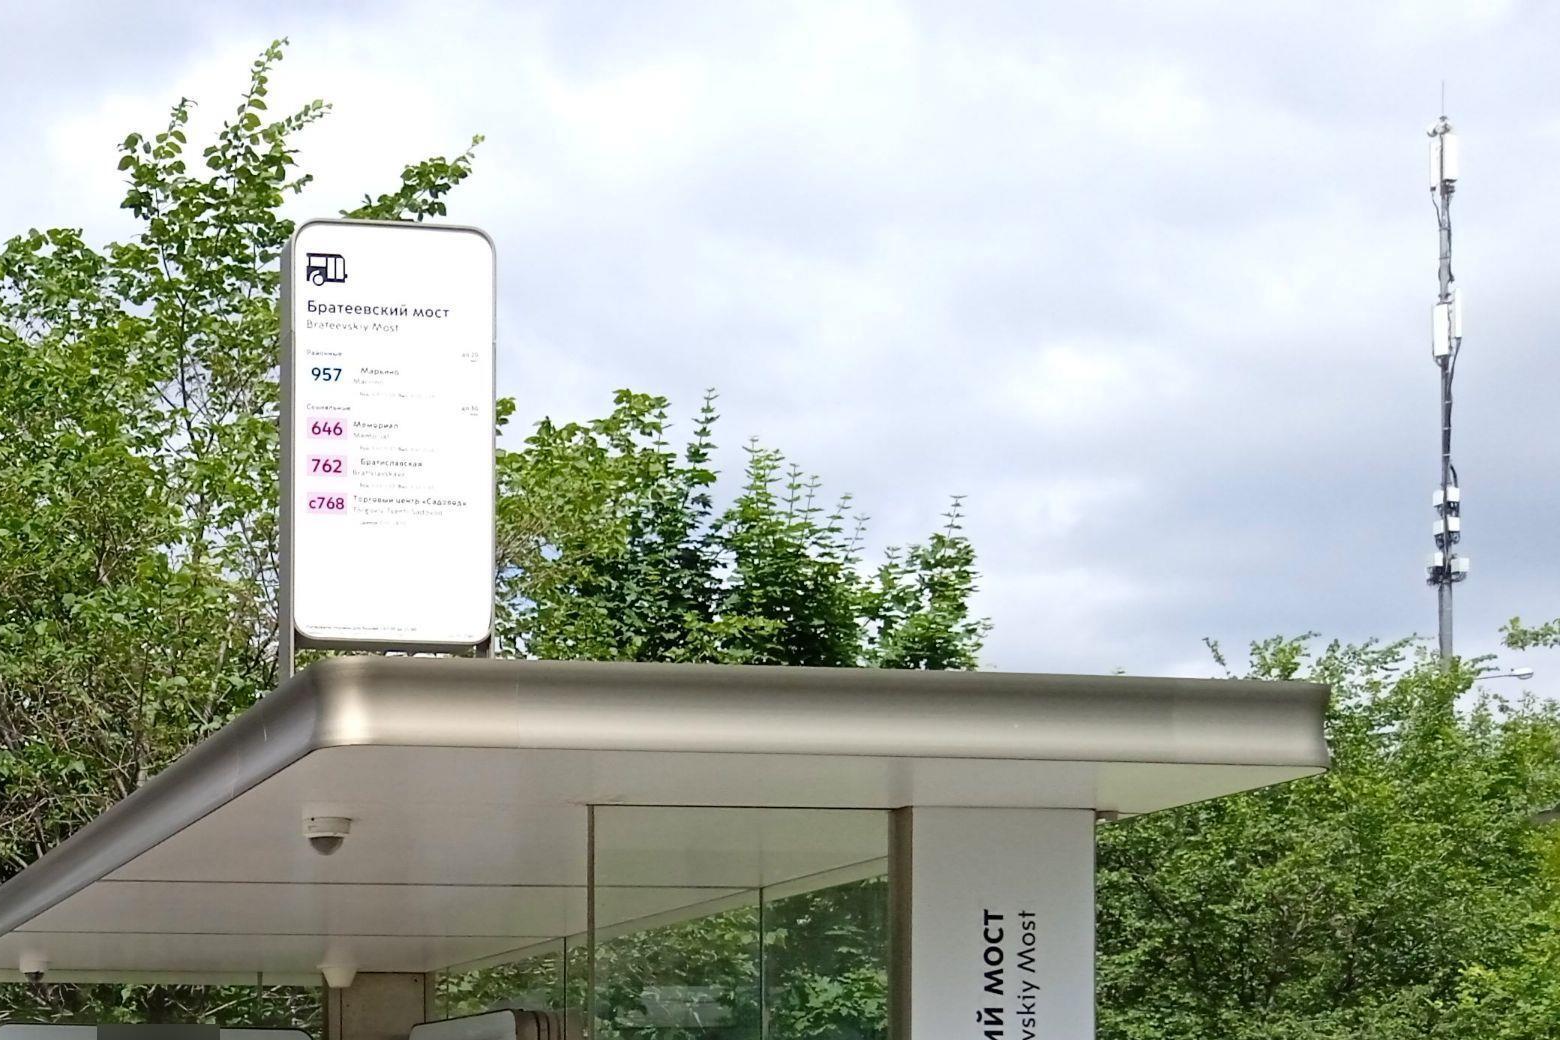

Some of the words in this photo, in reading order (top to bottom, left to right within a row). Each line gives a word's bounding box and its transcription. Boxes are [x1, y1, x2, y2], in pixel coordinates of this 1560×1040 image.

[306, 299, 408, 317] Братеевский
[412, 307, 451, 319] мост
[306, 319, 369, 333] Brateevskiy
[371, 322, 400, 333] Most
[311, 366, 343, 382] 957
[311, 420, 344, 437] 646
[311, 458, 343, 474] 762
[1016, 909, 1037, 974] Most
[983, 908, 1005, 996] мост
